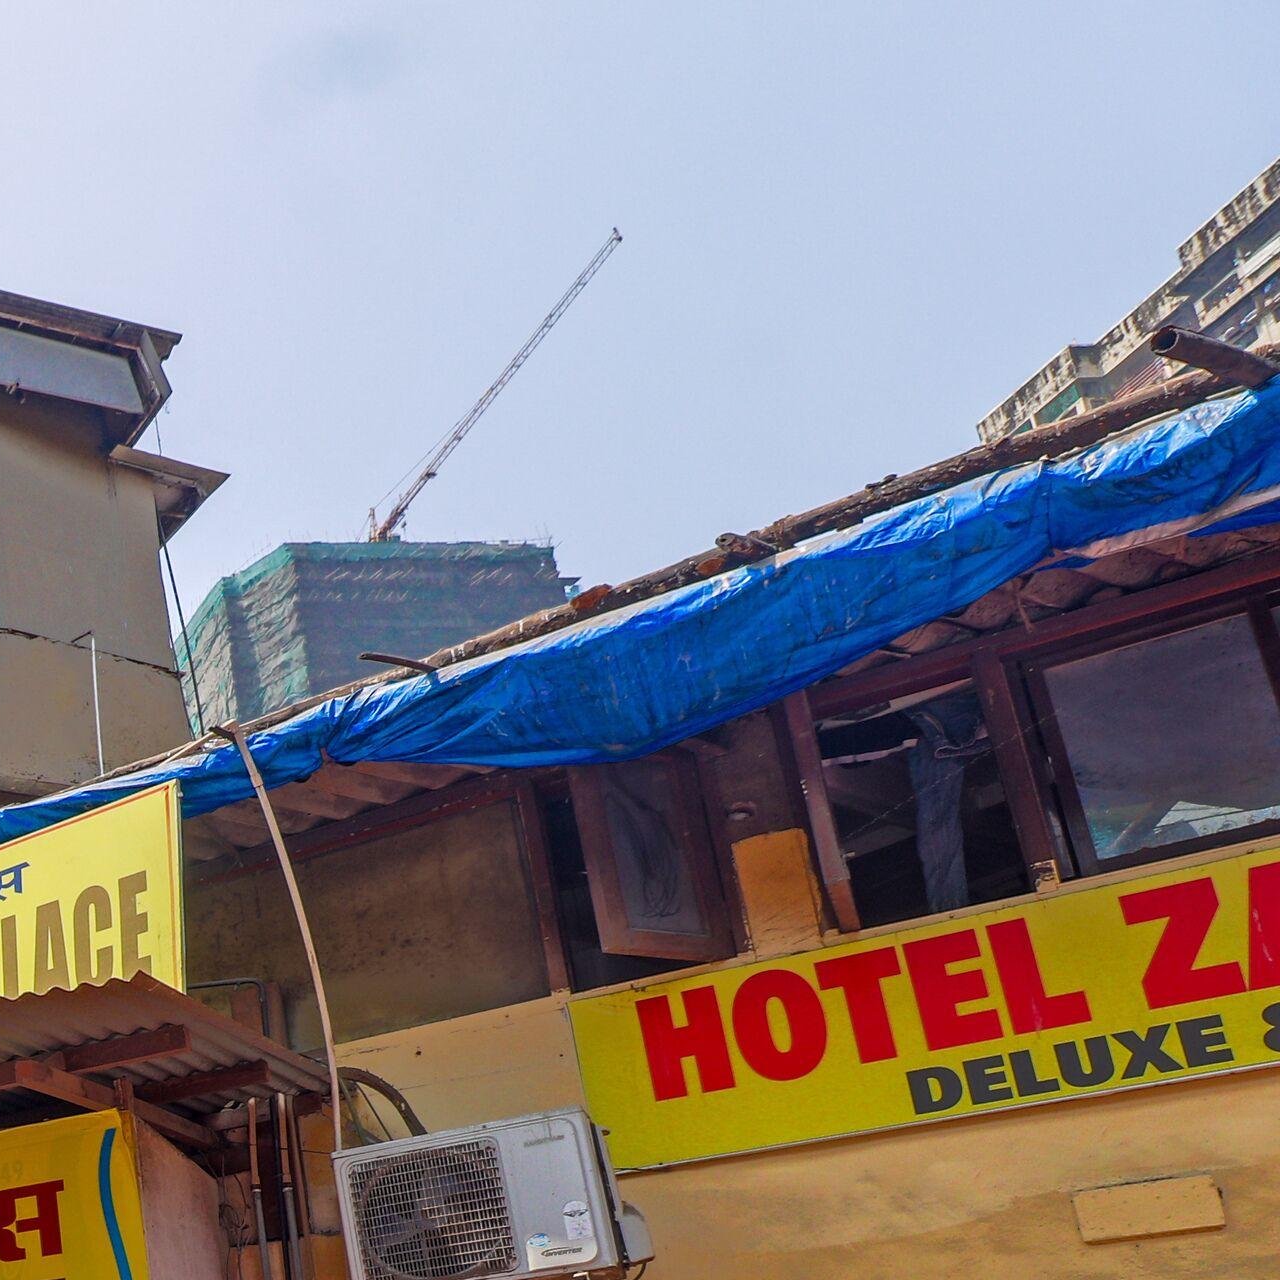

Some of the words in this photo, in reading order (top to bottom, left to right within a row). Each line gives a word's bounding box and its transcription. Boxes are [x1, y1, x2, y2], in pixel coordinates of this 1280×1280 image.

[635, 918, 1092, 1102] HOTEL
[1118, 862, 1280, 1010] Z
[906, 1014, 1234, 1115] DELUXE
